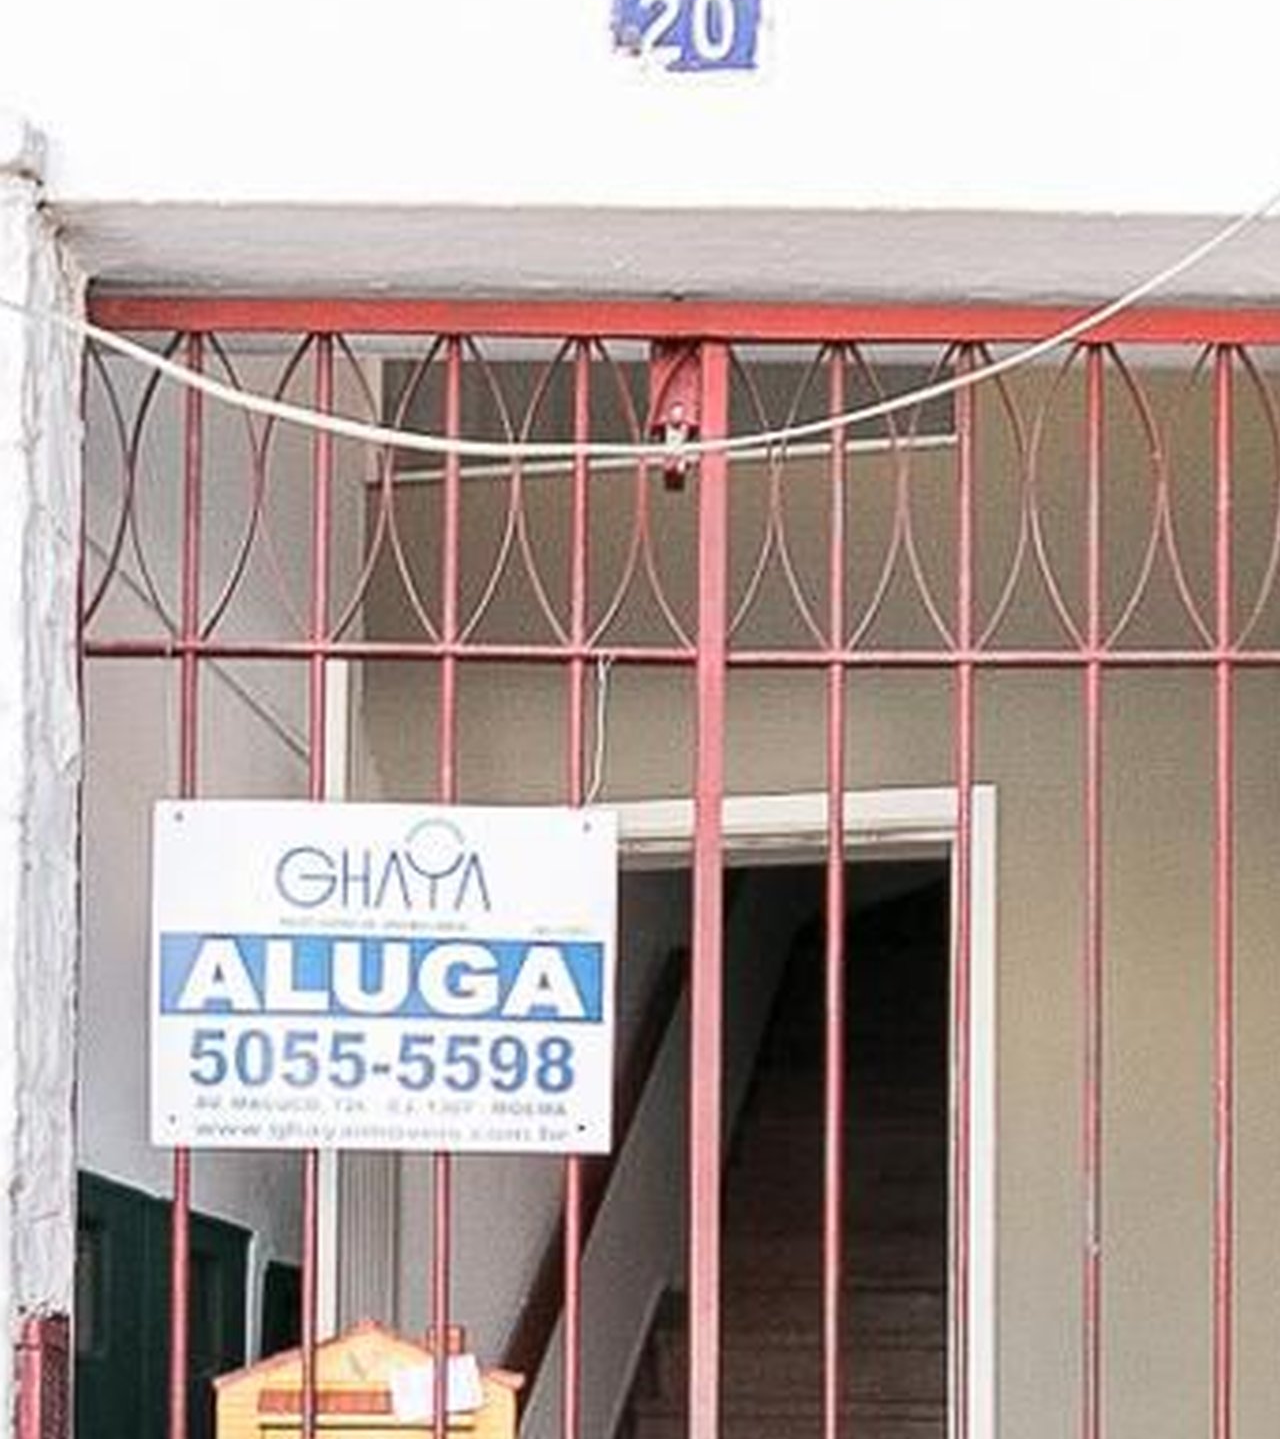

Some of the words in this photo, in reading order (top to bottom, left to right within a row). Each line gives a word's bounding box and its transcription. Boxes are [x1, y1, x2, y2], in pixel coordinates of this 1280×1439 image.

[275, 845, 492, 912] GHAYA
[176, 938, 588, 1018] ALUGA
[189, 1027, 575, 1094] 5055-5598
